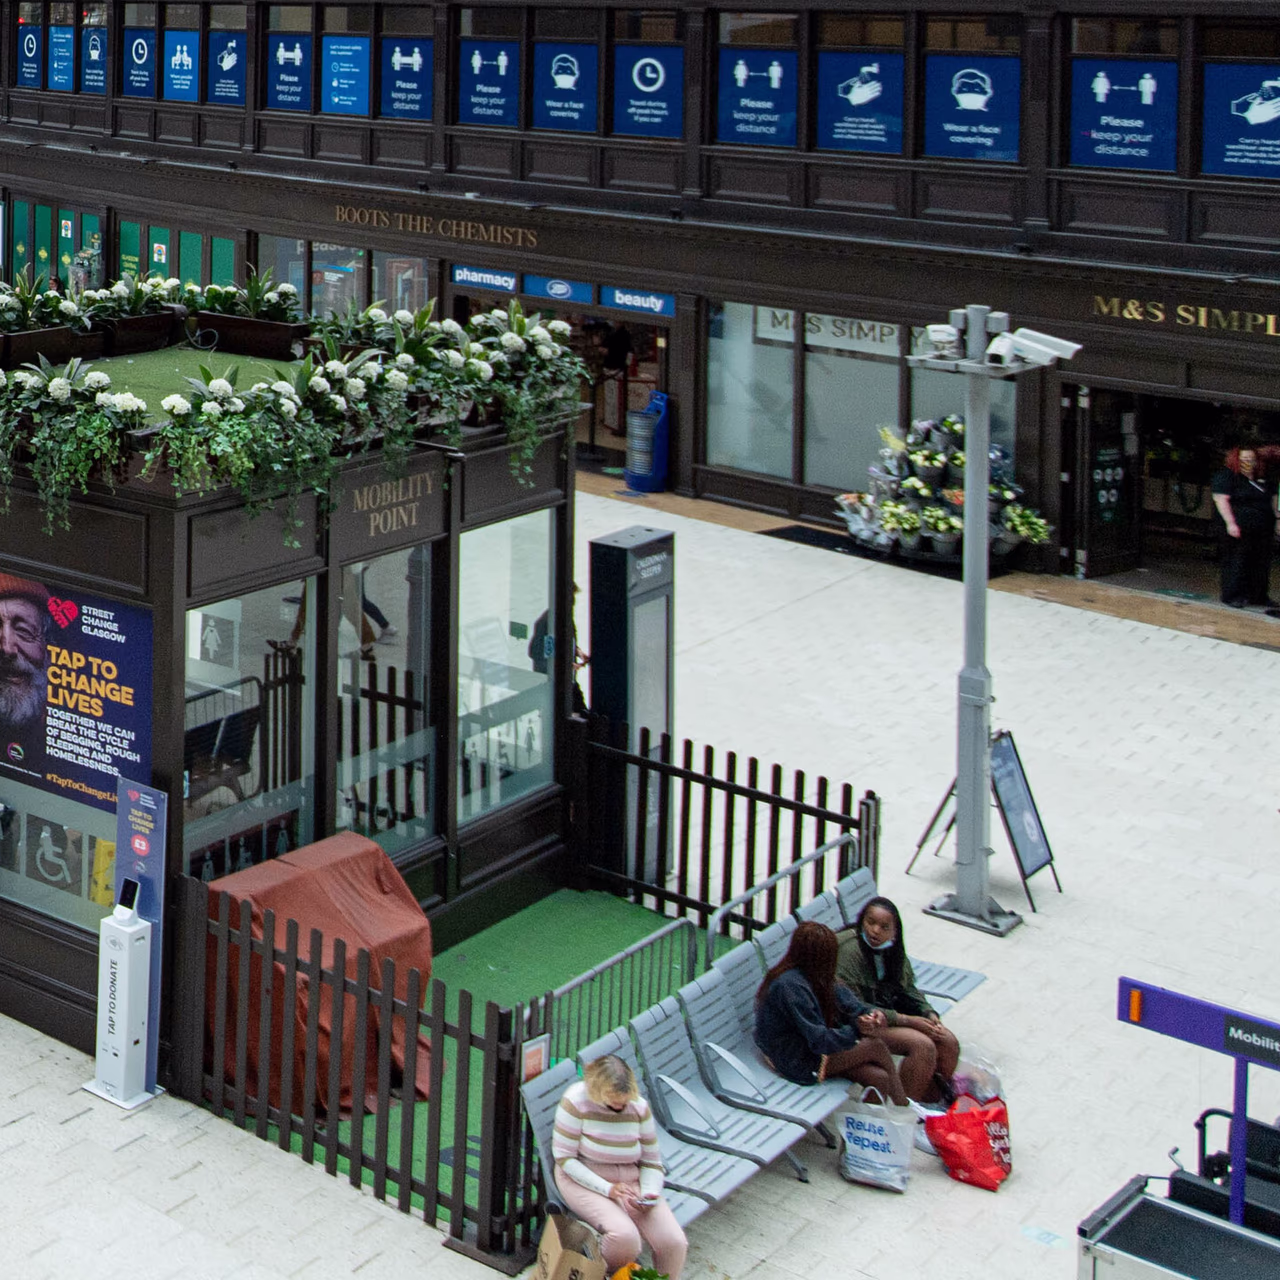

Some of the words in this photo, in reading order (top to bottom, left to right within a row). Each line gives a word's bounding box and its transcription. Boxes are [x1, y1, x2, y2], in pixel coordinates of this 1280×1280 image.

[1100, 116, 1144, 128] Please
[1091, 130, 1122, 142] keep
[1123, 133, 1153, 143] your
[1094, 144, 1149, 157] distance
[335, 205, 391, 228] BOOTS
[395, 213, 433, 234] THE
[438, 219, 538, 249] CHEMISTS
[455, 267, 516, 293] pharmacy
[614, 290, 664, 312] beauty
[1092, 295, 1165, 322] M&S
[352, 472, 433, 513] MOBILITY
[369, 502, 419, 536] POINT
[82, 605, 115, 620] STREET
[82, 615, 119, 632] CHANGE
[82, 625, 126, 644] GLASGOW
[47, 645, 86, 669] TAP
[88, 656, 117, 680] TO
[47, 666, 135, 706] CHANGE
[47, 685, 104, 717] LIVES
[46, 707, 96, 729] TOGETHER
[97, 720, 113, 734] WE
[114, 726, 135, 741] CAN
[46, 717, 77, 733] BREAK
[78, 725, 97, 739] THE
[98, 732, 130, 749] CYCLE
[46, 728, 59, 739] OF
[60, 732, 104, 753] BEGGING,
[105, 744, 140, 763] ROUGH
[46, 737, 90, 758] SLEEPING
[91, 750, 112, 764] AND
[46, 746, 121, 777] HOMELESSNESS.
[109, 959, 118, 1001] DONATE
[109, 1001, 116, 1013] TO
[108, 1013, 116, 1036] TAP
[845, 1116, 888, 1137] Reuse.
[846, 1132, 896, 1154] Repeat.
